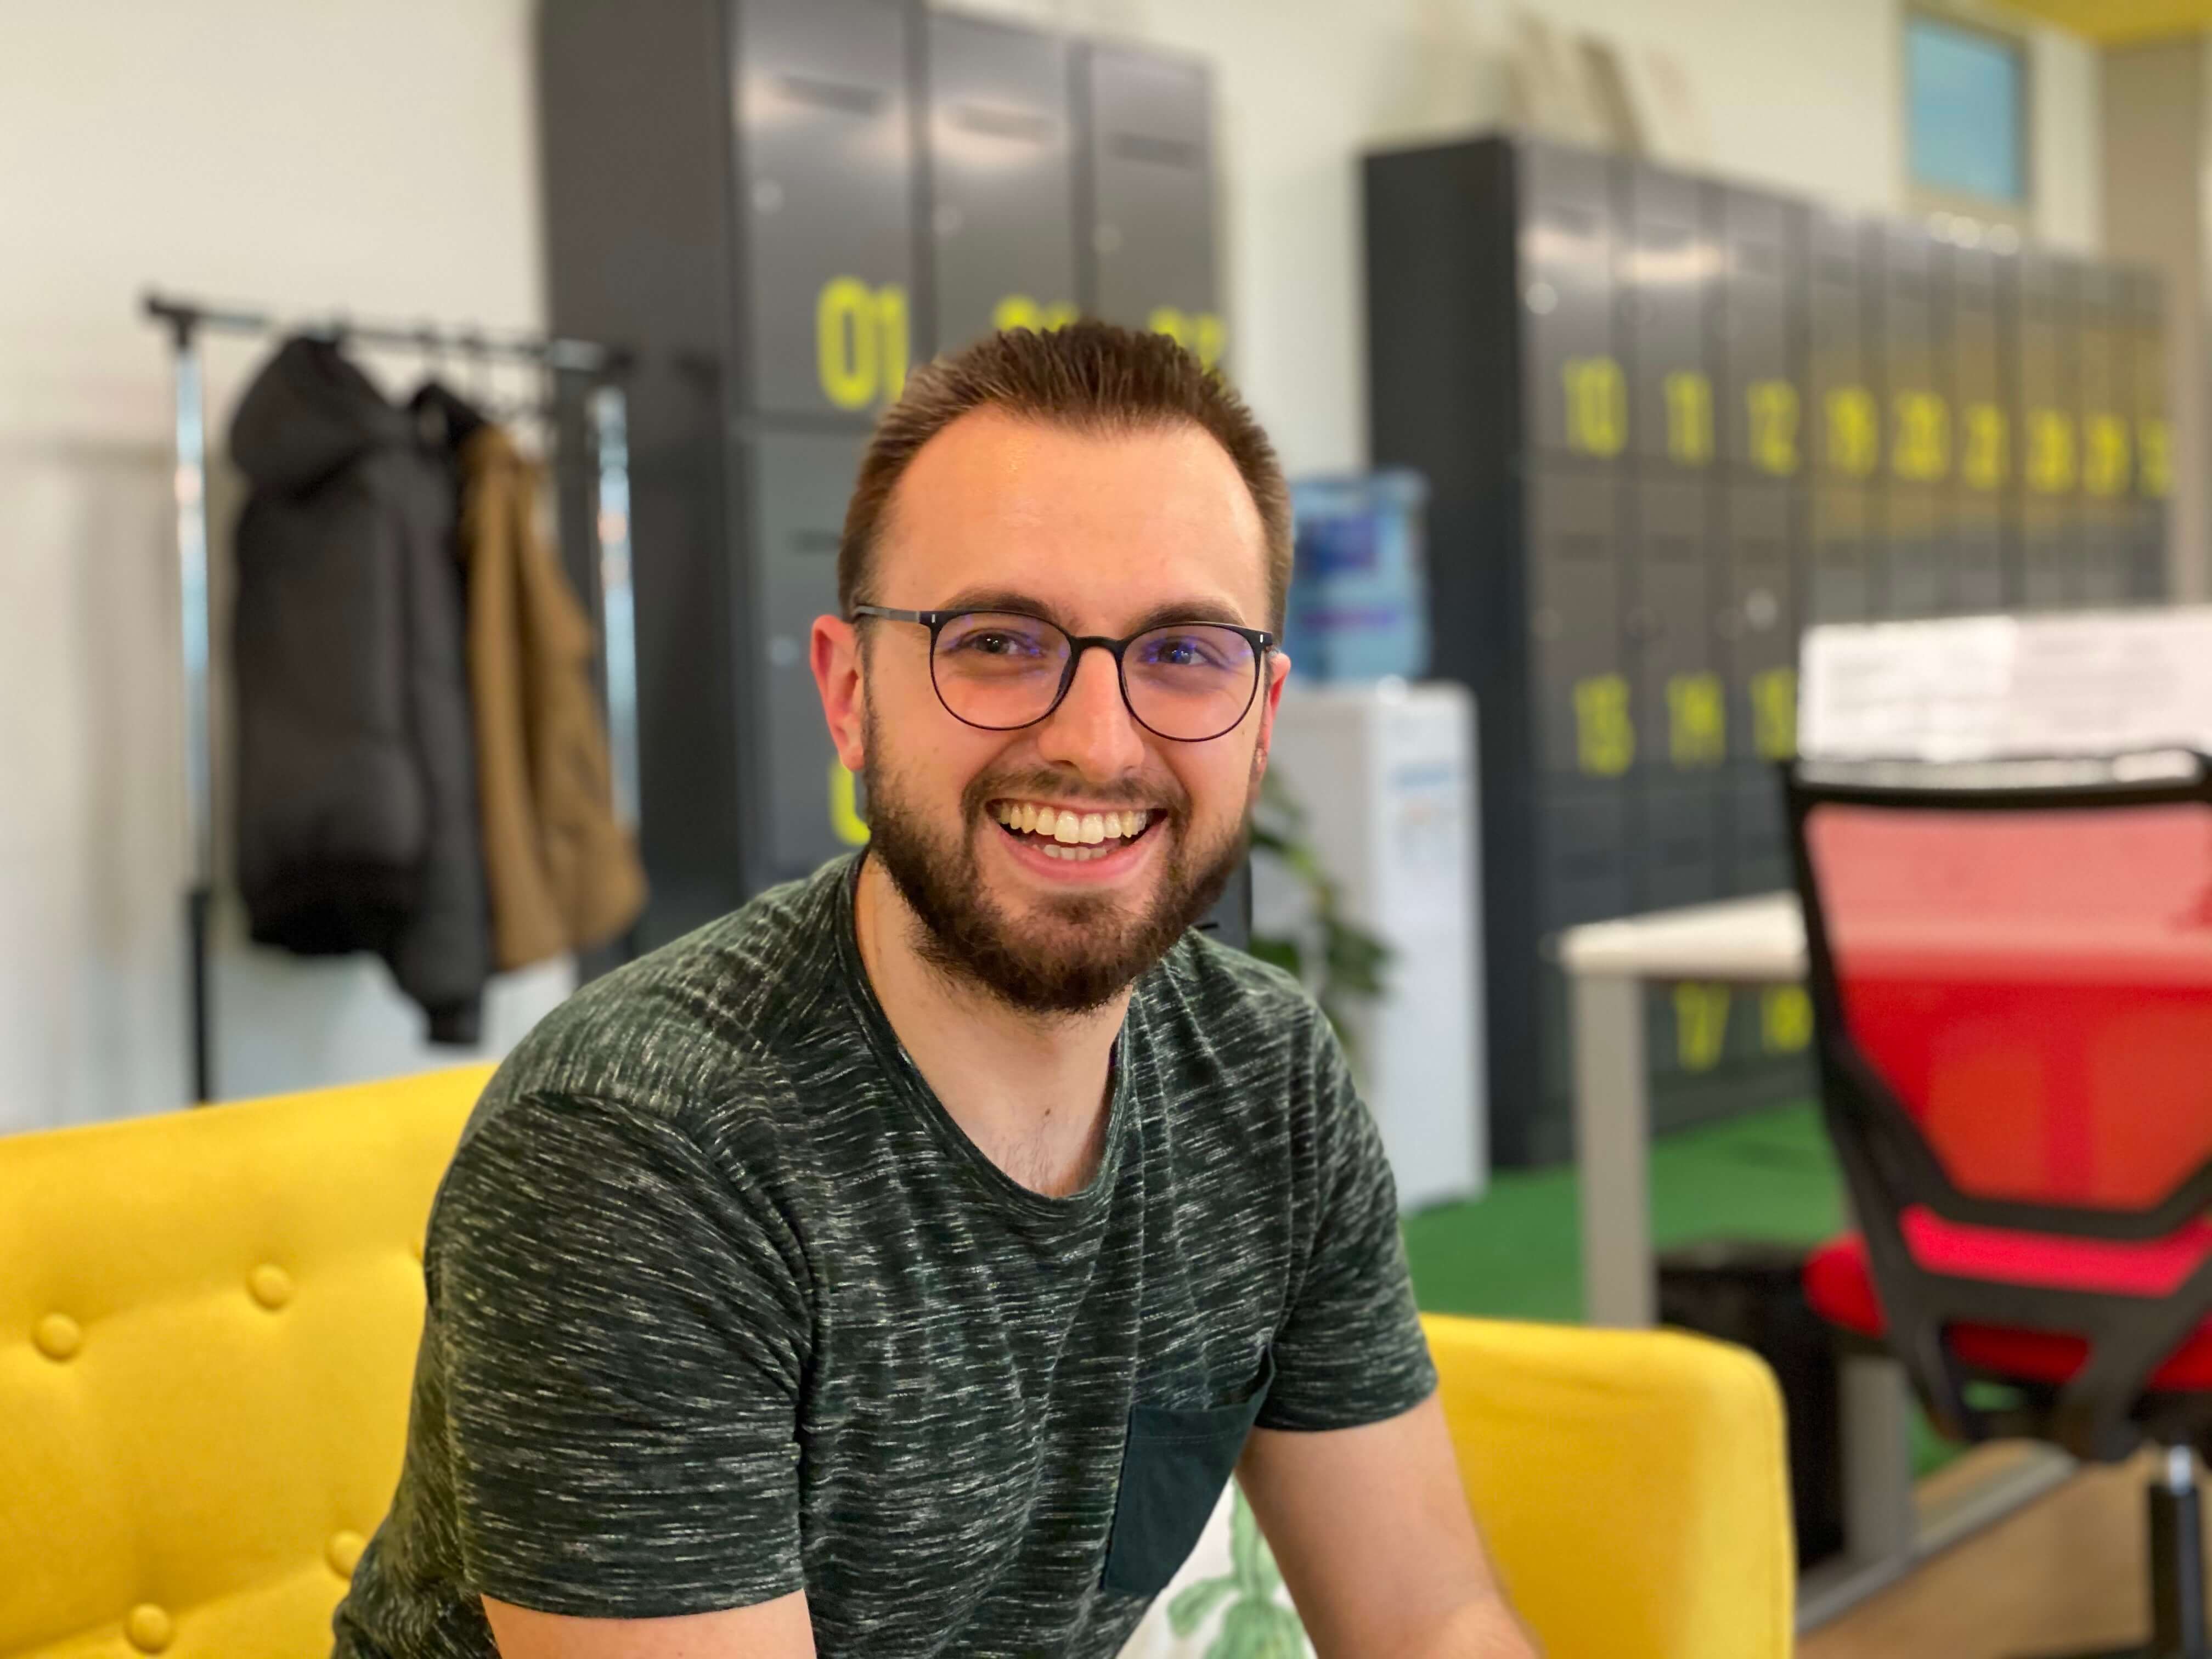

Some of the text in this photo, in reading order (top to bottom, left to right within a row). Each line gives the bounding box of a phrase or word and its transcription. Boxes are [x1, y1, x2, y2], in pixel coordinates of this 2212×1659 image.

[817, 278, 909, 409] 01
[1564, 358, 1627, 458] 10
[1663, 371, 1713, 465] 11
[1748, 381, 1799, 476] 12
